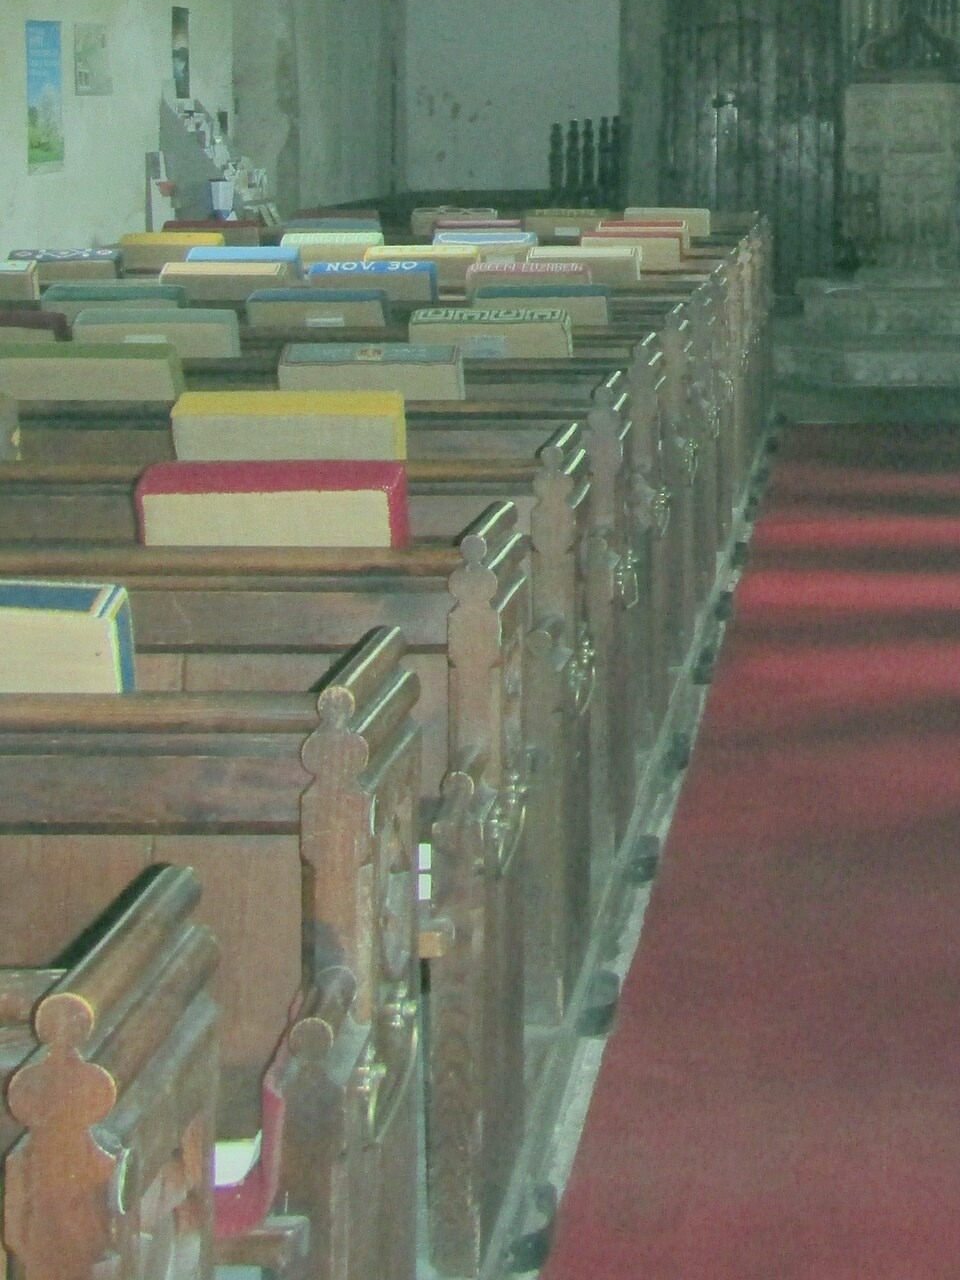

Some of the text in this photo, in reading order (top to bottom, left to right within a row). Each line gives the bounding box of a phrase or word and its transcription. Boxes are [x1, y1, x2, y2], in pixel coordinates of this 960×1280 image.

[325, 261, 418, 272] NOV. 30
[470, 262, 516, 273] QUEEN
